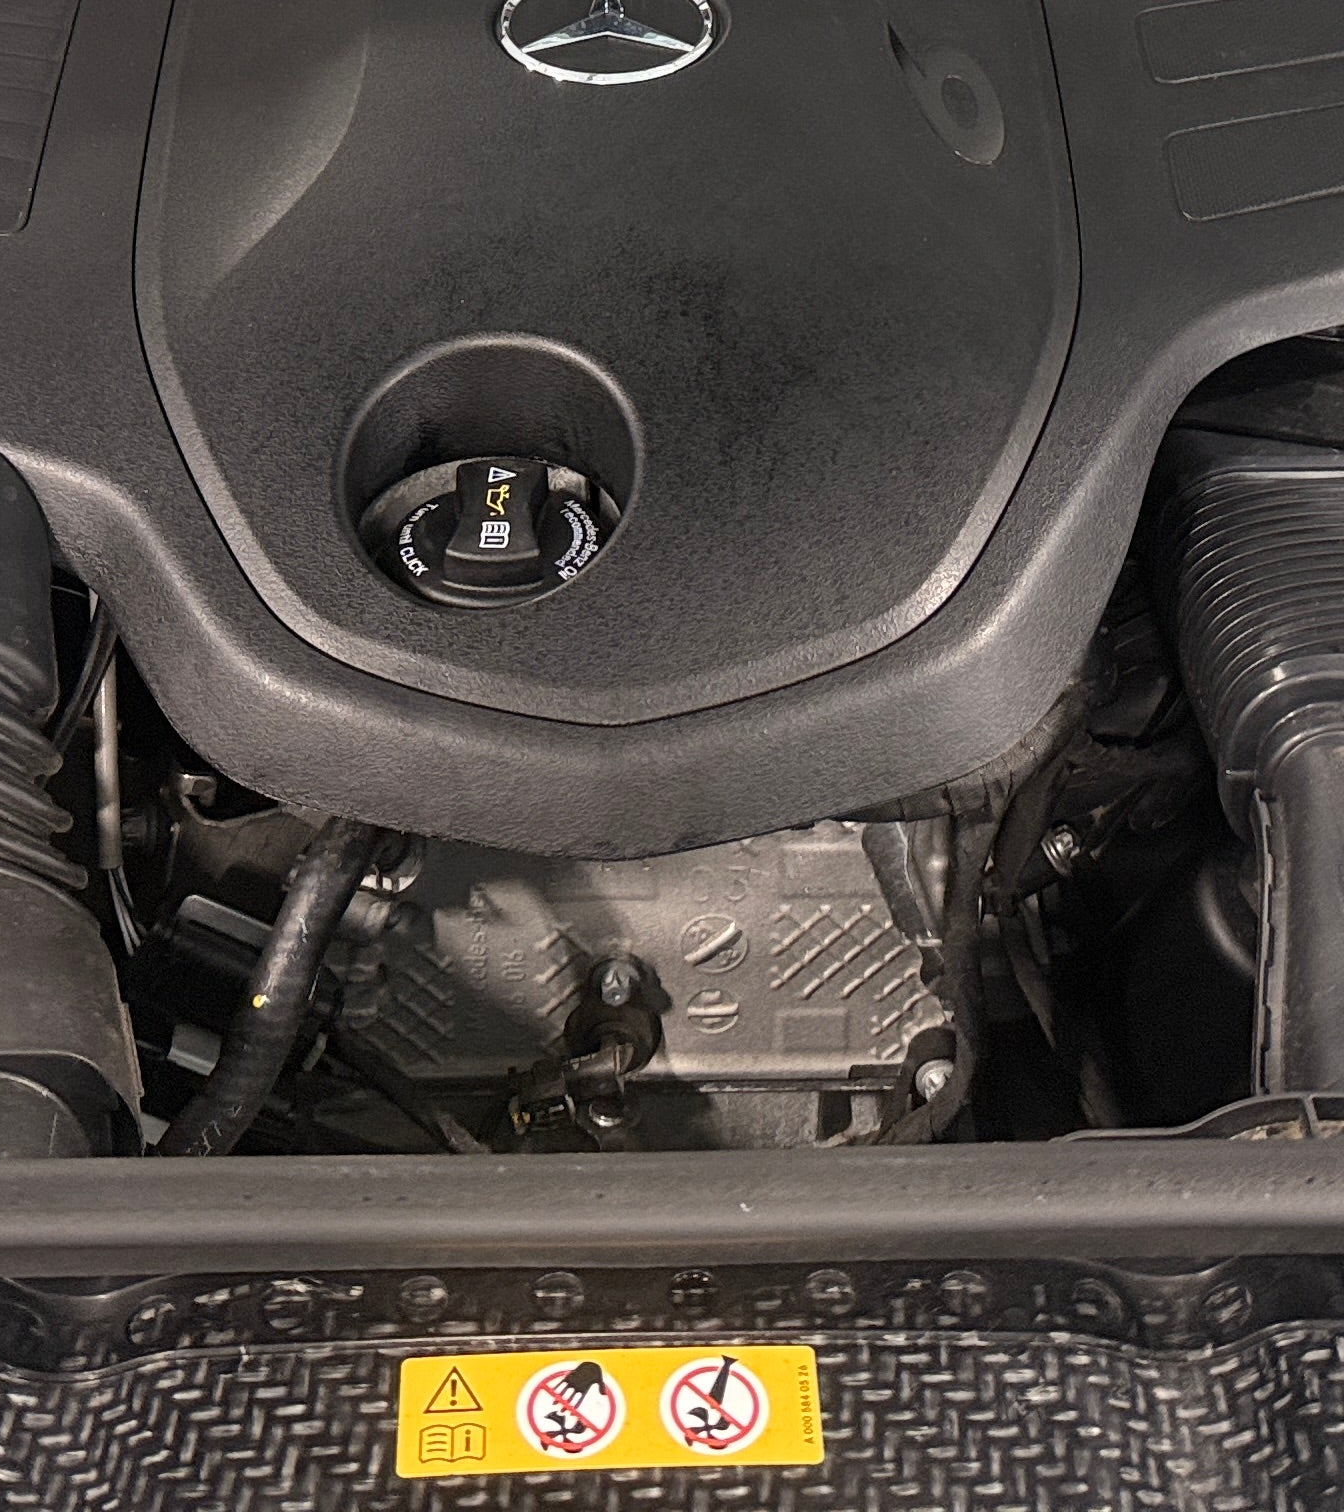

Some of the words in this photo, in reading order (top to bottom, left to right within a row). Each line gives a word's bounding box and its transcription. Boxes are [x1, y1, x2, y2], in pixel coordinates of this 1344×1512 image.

[563, 499, 600, 568] Mercedes-Benz
[399, 546, 430, 577] CLICK
[557, 565, 578, 581] Oil
[803, 1436, 815, 1445] A
